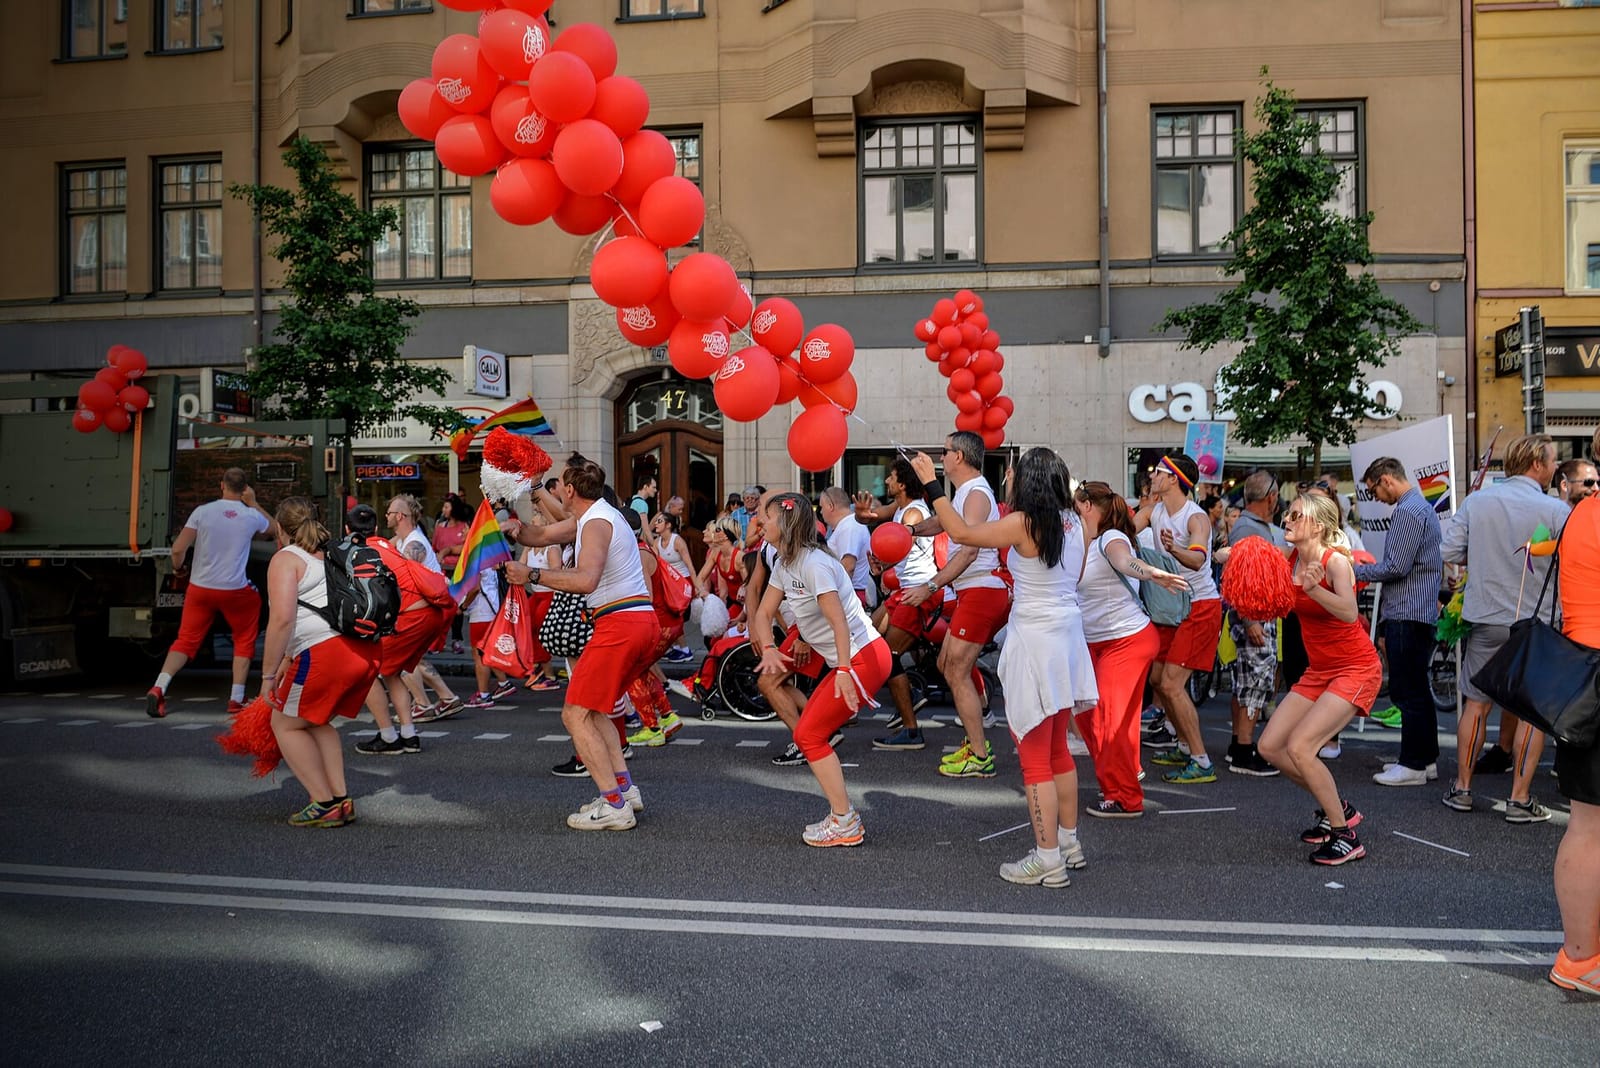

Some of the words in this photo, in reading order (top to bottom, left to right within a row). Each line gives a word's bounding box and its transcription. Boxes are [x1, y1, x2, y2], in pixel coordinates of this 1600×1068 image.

[661, 390, 686, 408] 47
[357, 466, 414, 477] PIERCING
[19, 658, 72, 673] SCANIA
